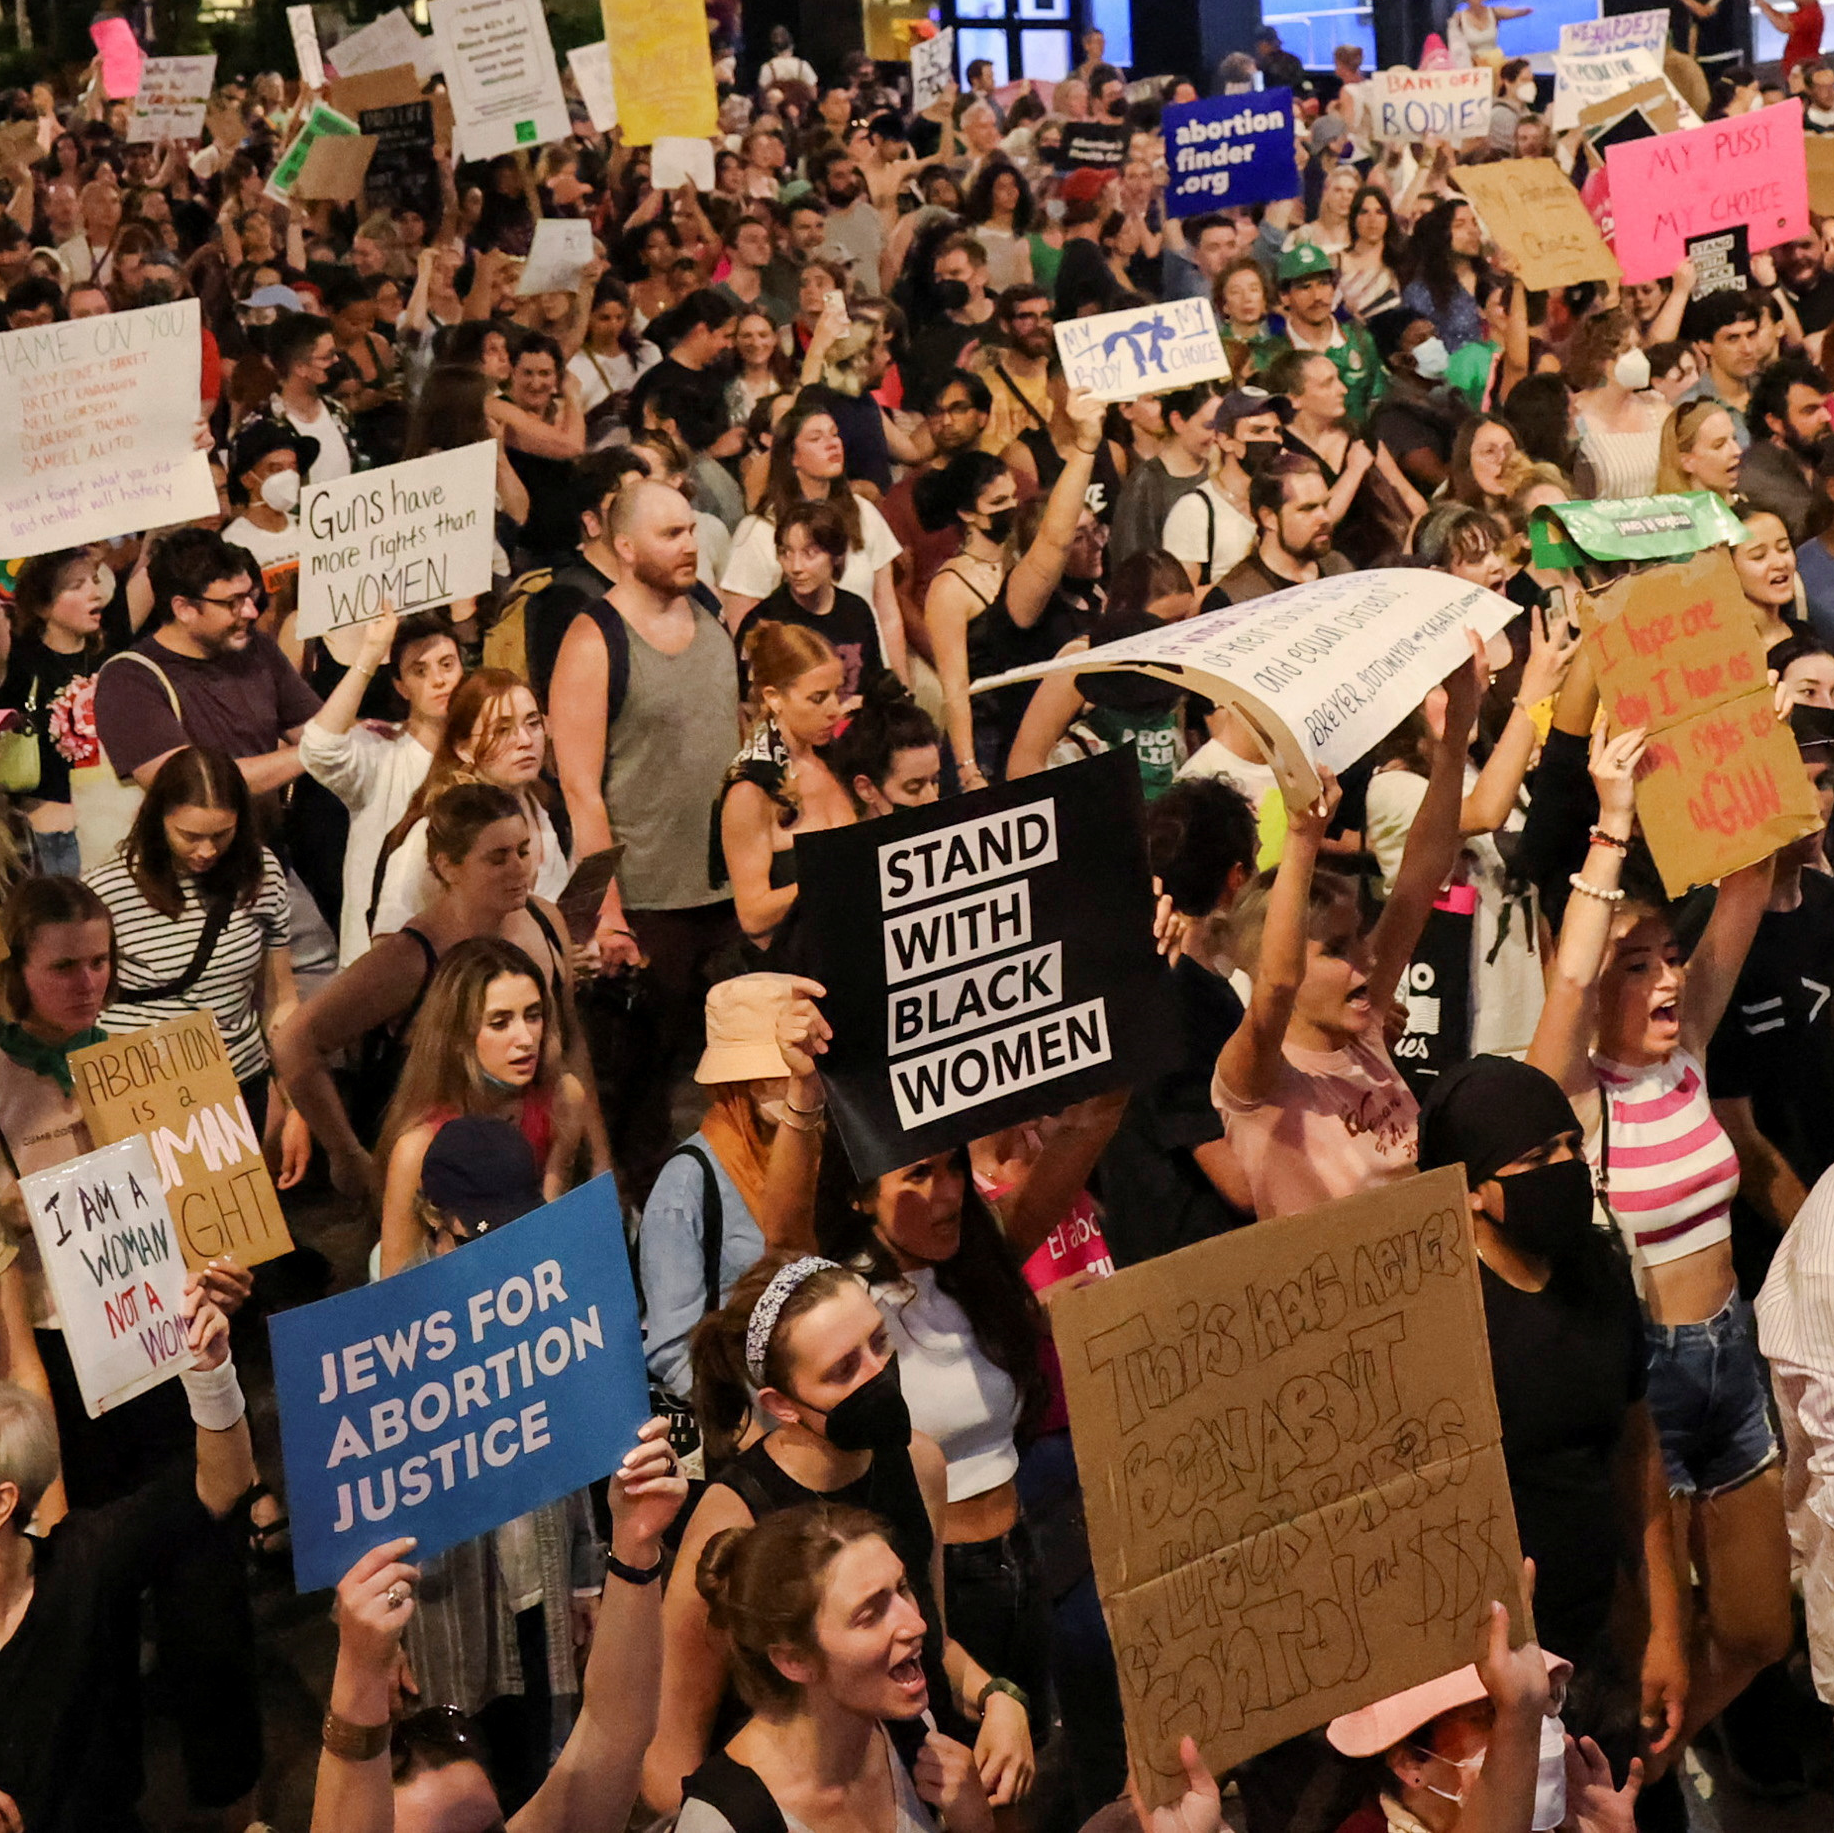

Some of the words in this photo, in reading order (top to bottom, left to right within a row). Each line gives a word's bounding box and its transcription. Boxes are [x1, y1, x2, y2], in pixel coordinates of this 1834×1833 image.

[1175, 108, 1285, 146] abortion
[1176, 142, 1256, 172] finder
[1176, 170, 1230, 197] .org
[1709, 180, 1783, 222] CHOICE
[93, 319, 133, 355] ON
[145, 307, 185, 341] YOU
[308, 490, 388, 542] Guns
[390, 479, 447, 515] have
[310, 544, 362, 576] more
[369, 526, 427, 572] rights
[433, 508, 477, 540] than
[325, 552, 451, 625] WOMEN
[1253, 658, 1303, 694] and
[1587, 622, 1619, 676] I
[887, 812, 1050, 899] STAND
[890, 892, 1022, 971] WITH
[894, 953, 1054, 1044] BLACK
[80, 1020, 222, 1106] ABORTION
[897, 1009, 1103, 1116] WOMEN
[130, 1099, 156, 1126] is
[178, 1085, 198, 1108] a
[44, 1191, 73, 1247] I
[77, 1180, 121, 1233] AM
[127, 1171, 150, 1210] A
[79, 1217, 170, 1288] WOMAN
[103, 1284, 141, 1340] NOT
[143, 1280, 165, 1314] A
[138, 1312, 194, 1368] WOM
[318, 1308, 457, 1406] JEWS
[468, 1258, 569, 1344] FOR
[324, 1303, 606, 1469] ABORTION
[331, 1401, 553, 1535] JUSTICE
